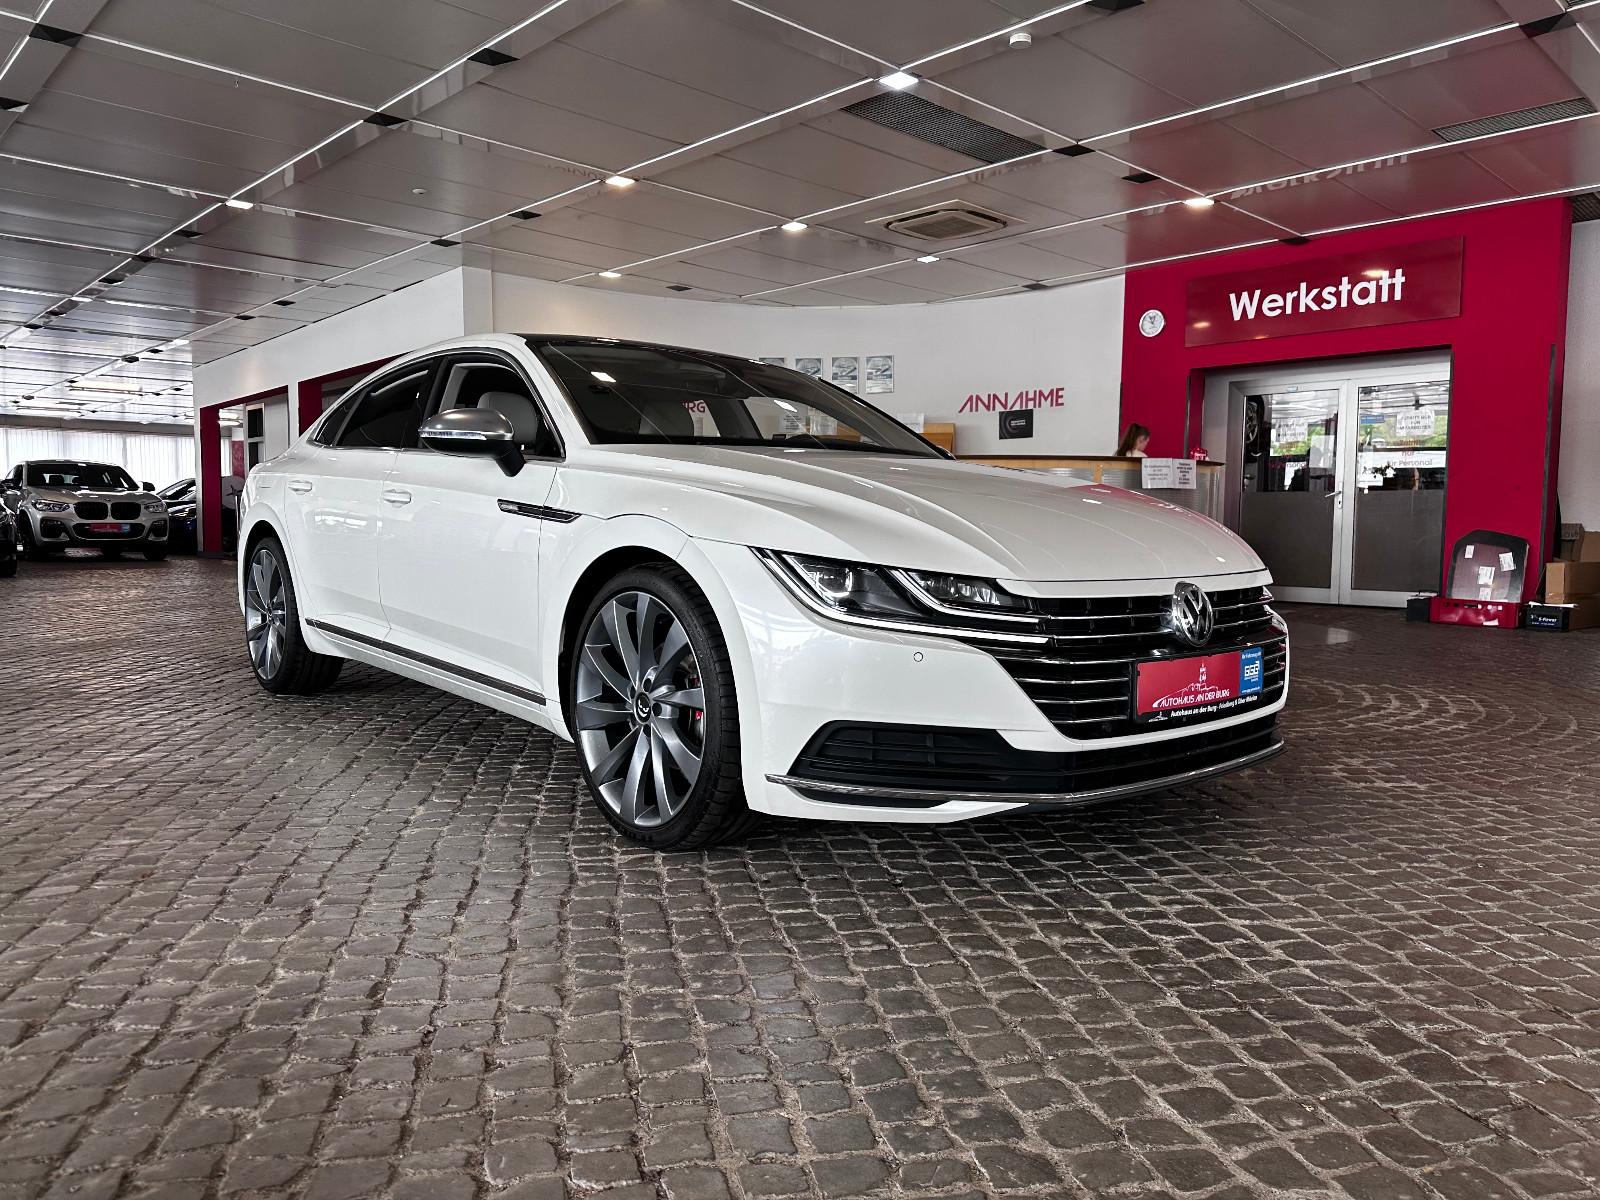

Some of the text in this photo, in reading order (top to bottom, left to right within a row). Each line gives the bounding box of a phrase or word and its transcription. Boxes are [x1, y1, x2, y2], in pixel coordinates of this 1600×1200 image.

[1229, 268, 1406, 321] Werkstatt
[958, 387, 1065, 414] ANNAHME
[1159, 695, 1195, 708] AUTOHAUS
[1195, 694, 1205, 703] AN
[1205, 691, 1216, 702] DER
[1216, 688, 1230, 699] BURG
[1170, 708, 1193, 718] Autohaus
